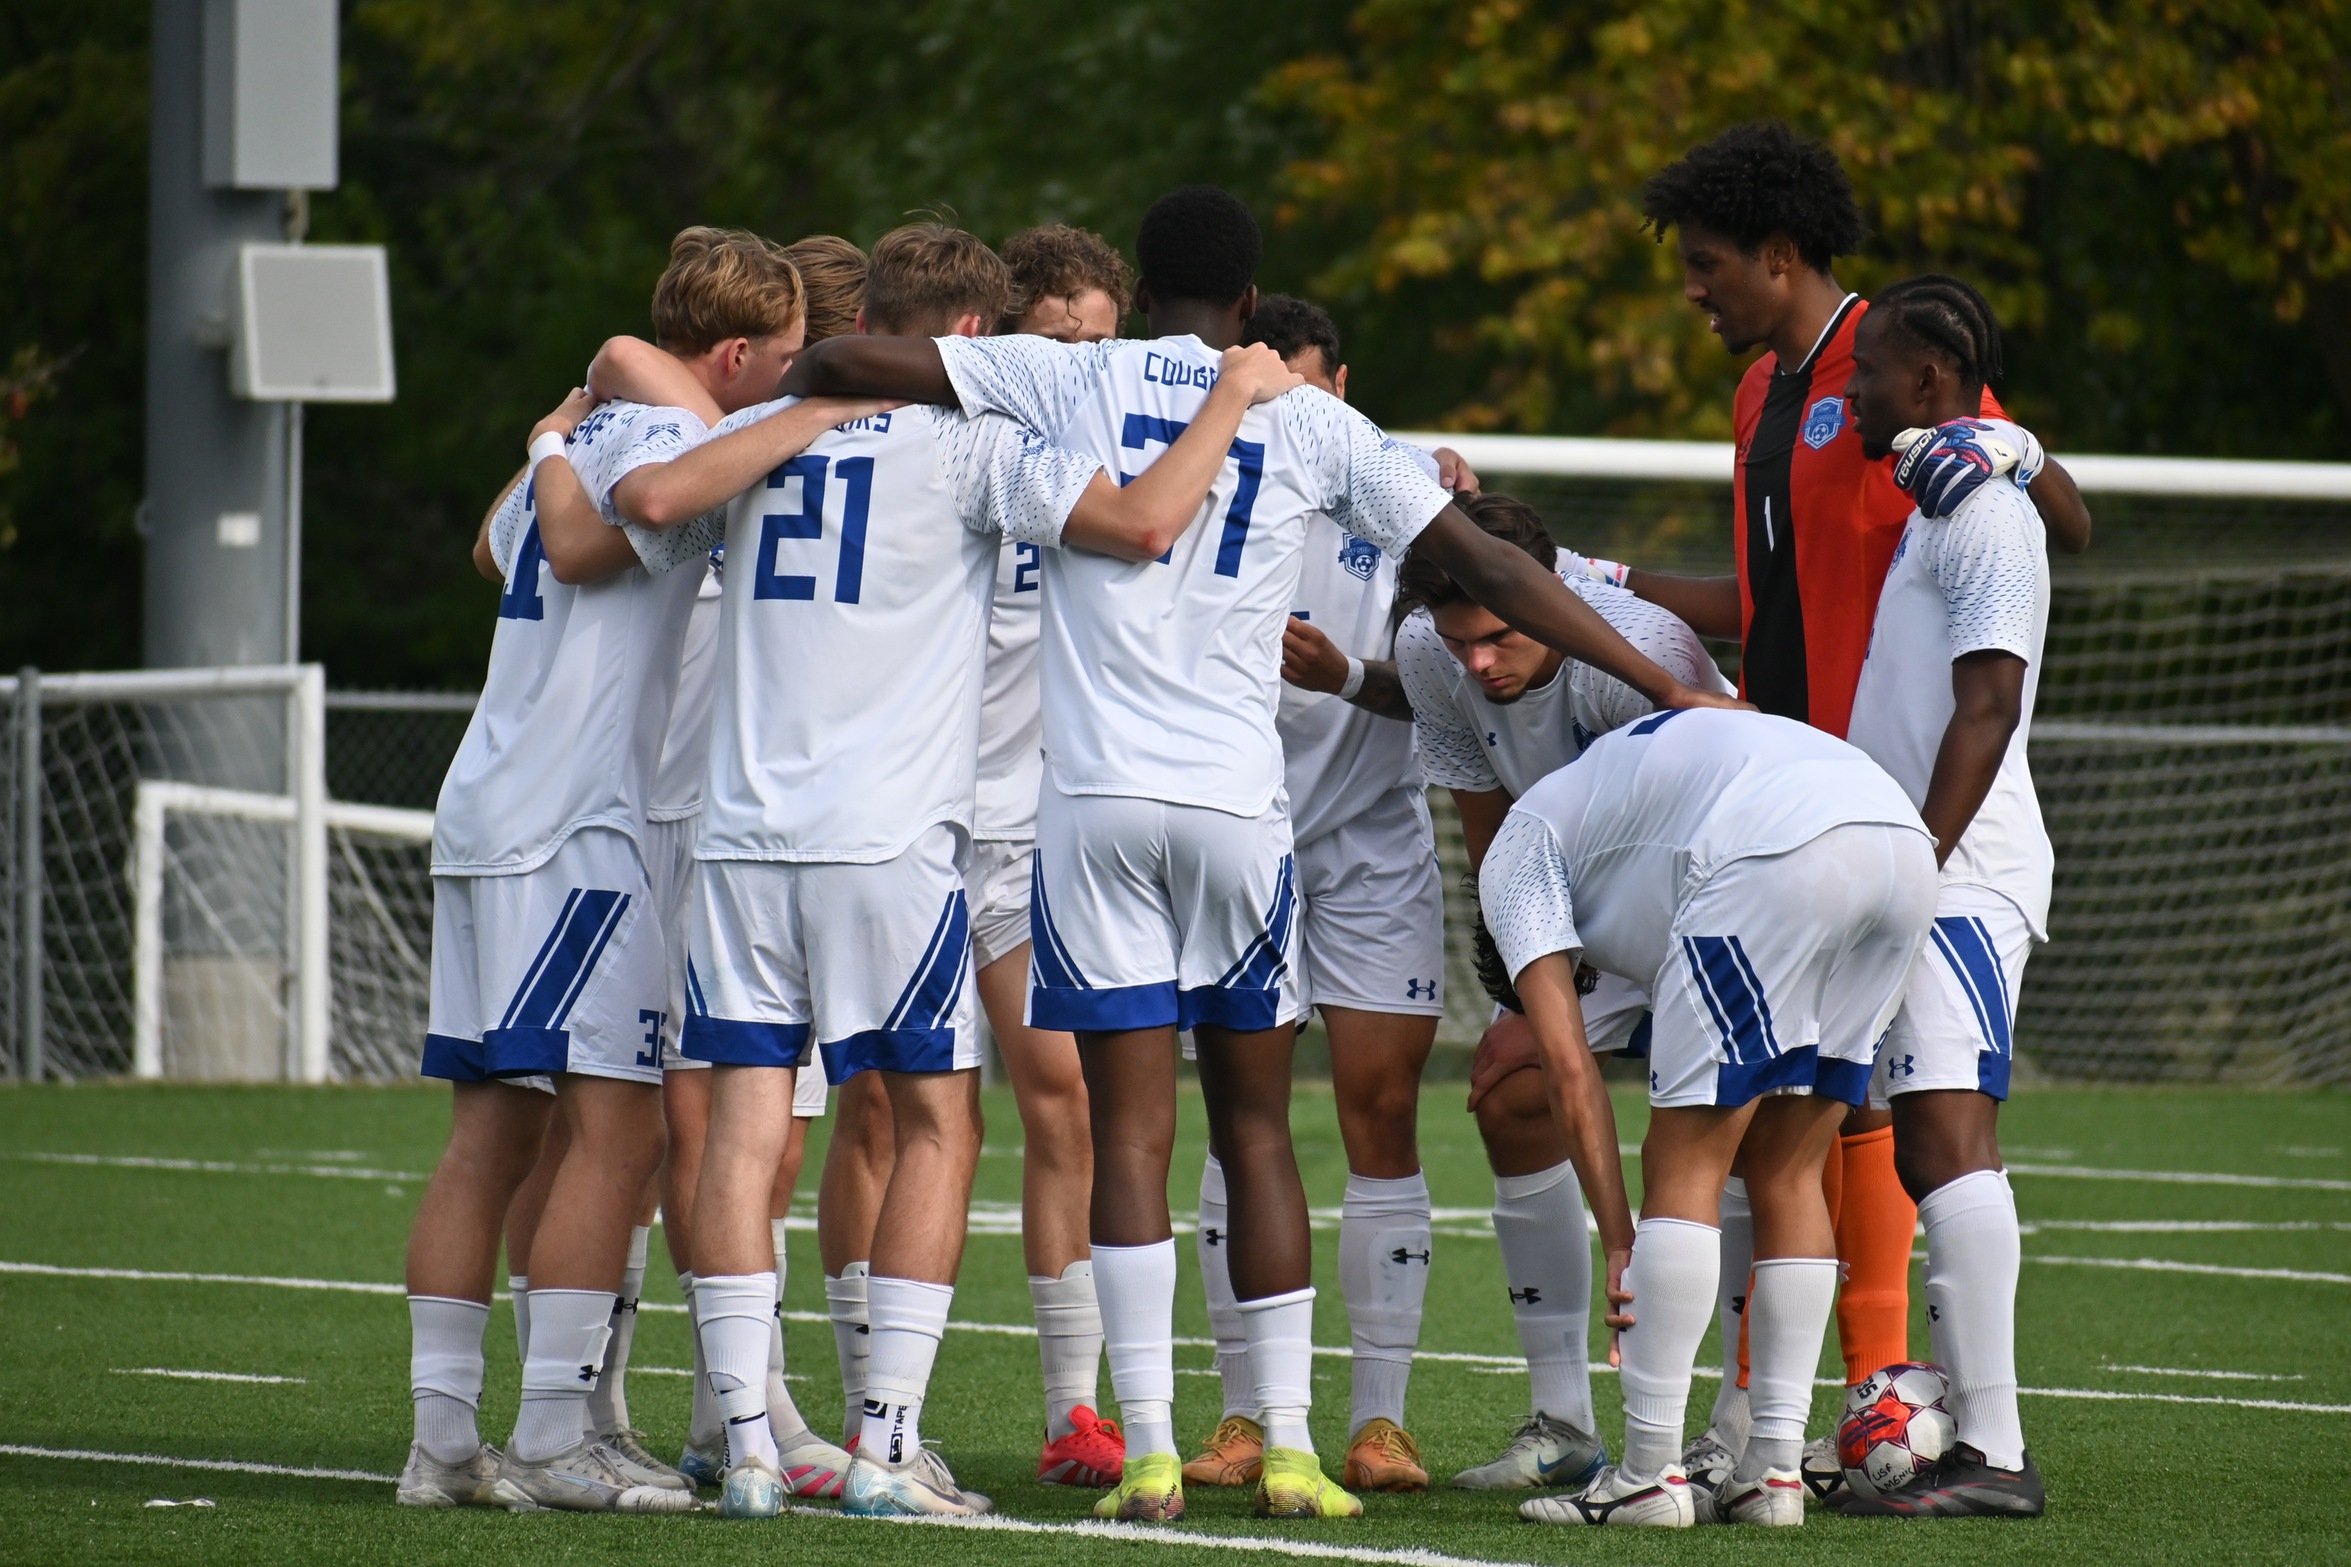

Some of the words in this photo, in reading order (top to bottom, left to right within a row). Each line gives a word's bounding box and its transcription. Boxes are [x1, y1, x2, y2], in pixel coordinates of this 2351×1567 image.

[1897, 427, 1938, 485] reusch
[753, 454, 875, 604] 21
[1764, 495, 1775, 552] 1
[1872, 1462, 1892, 1481] USF
